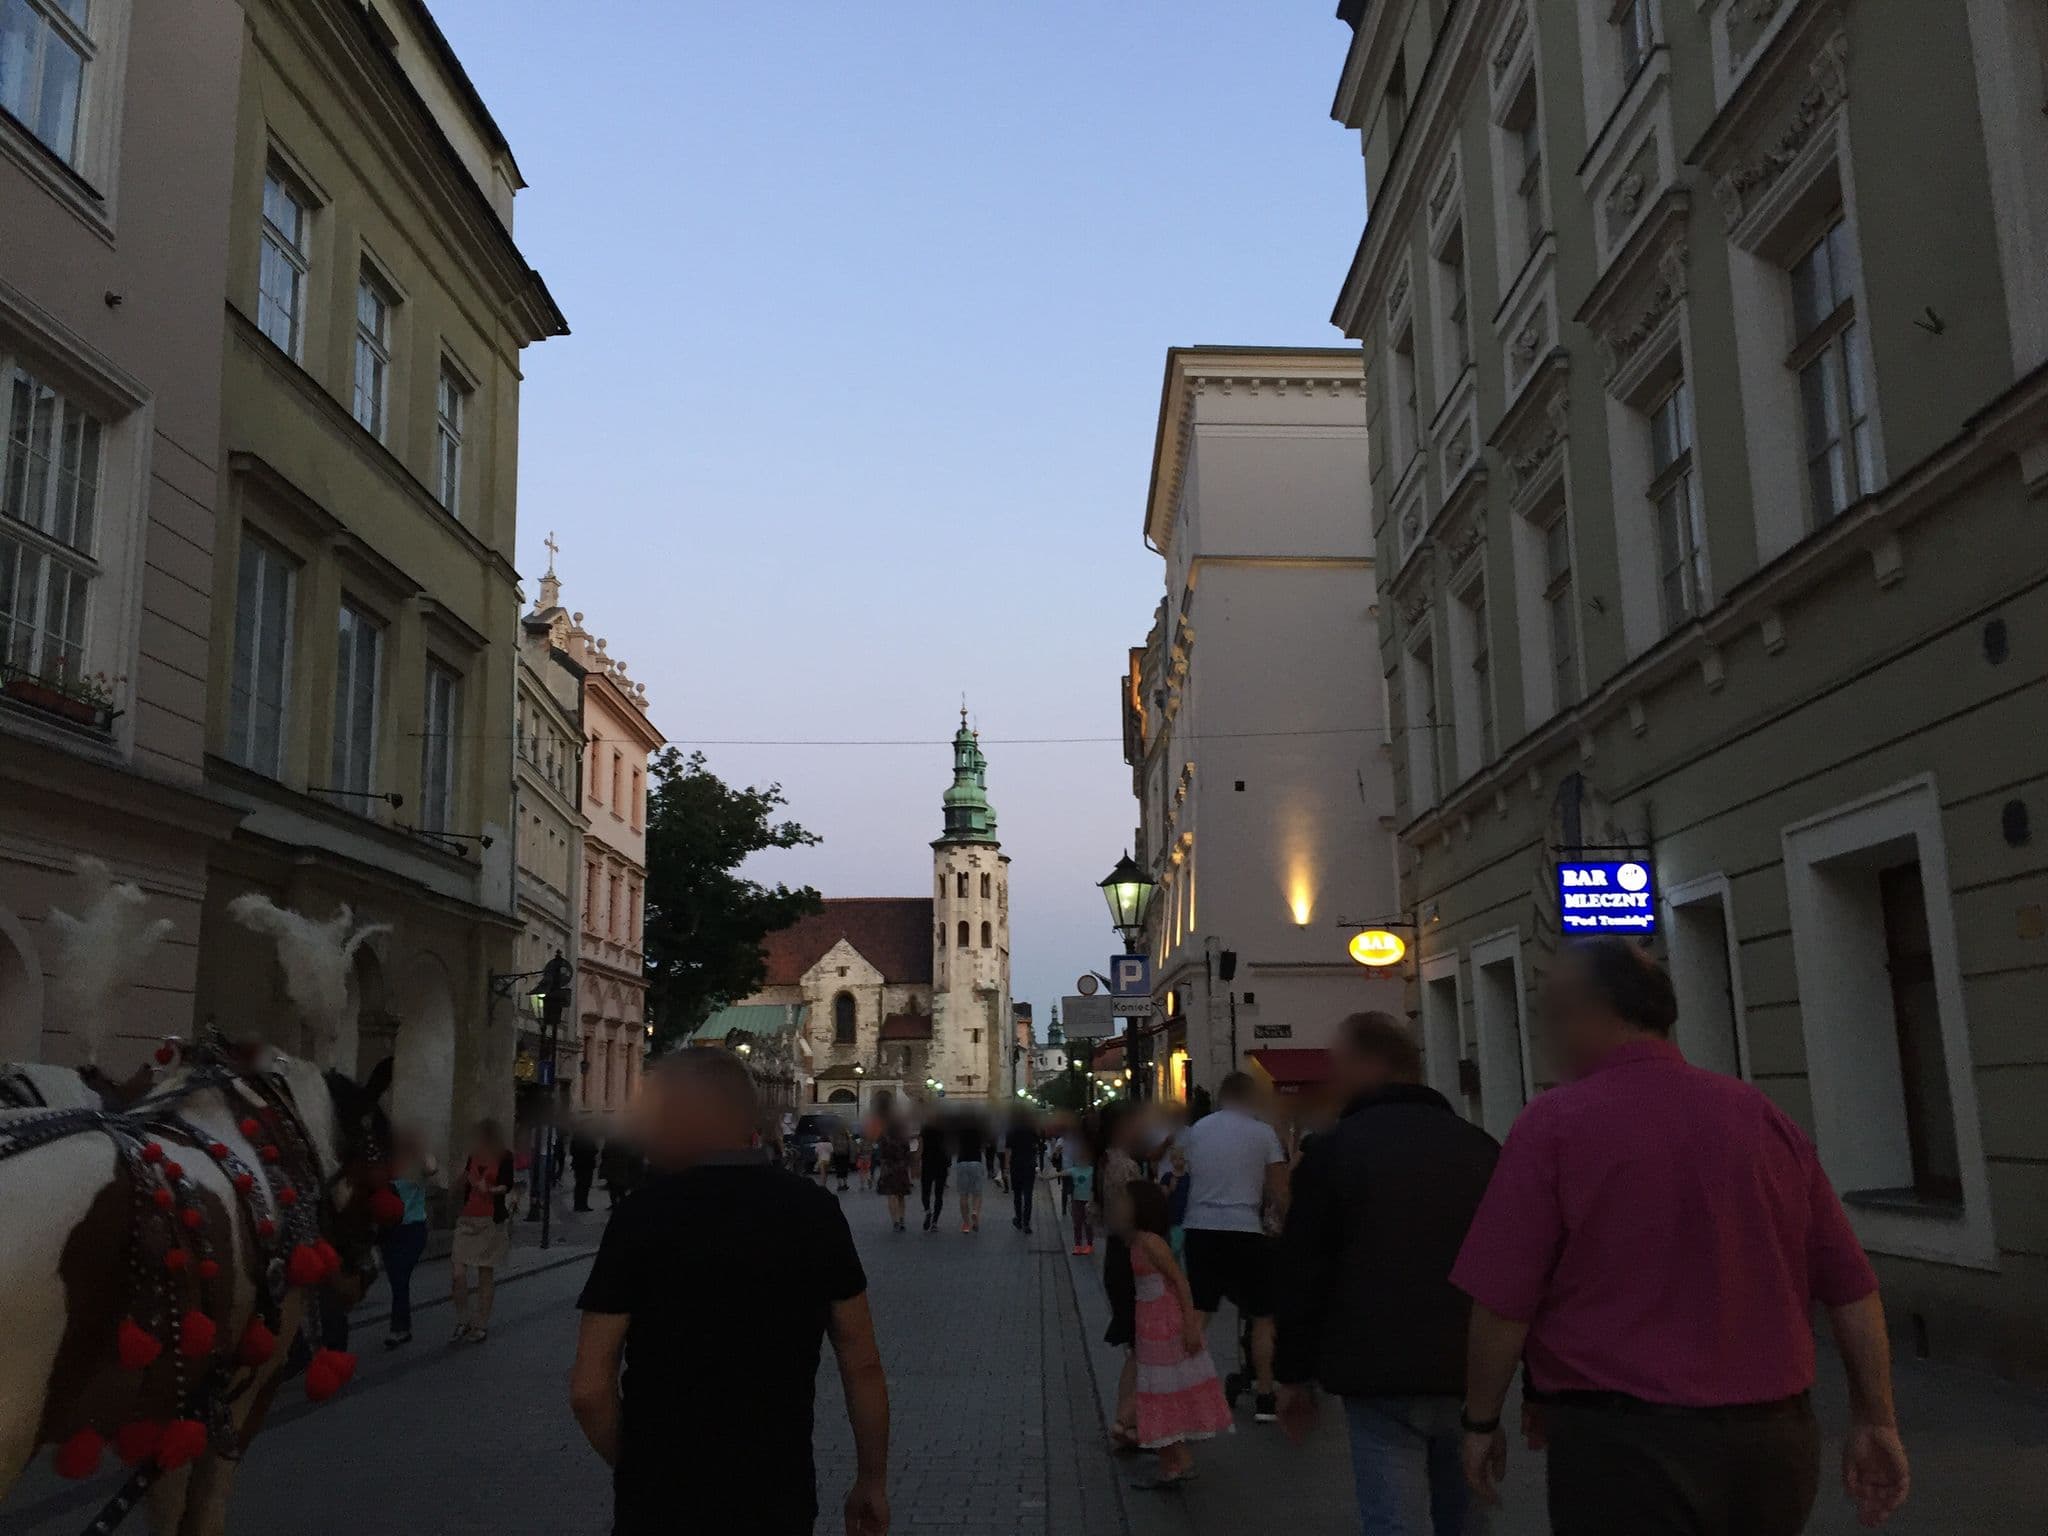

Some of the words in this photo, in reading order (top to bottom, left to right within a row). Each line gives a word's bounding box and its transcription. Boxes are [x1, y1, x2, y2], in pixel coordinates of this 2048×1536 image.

[1562, 869, 1608, 887] BAR
[1564, 892, 1649, 908] MLECZNY
[1120, 959, 1142, 991] P
[1113, 1001, 1151, 1012] Koniec
